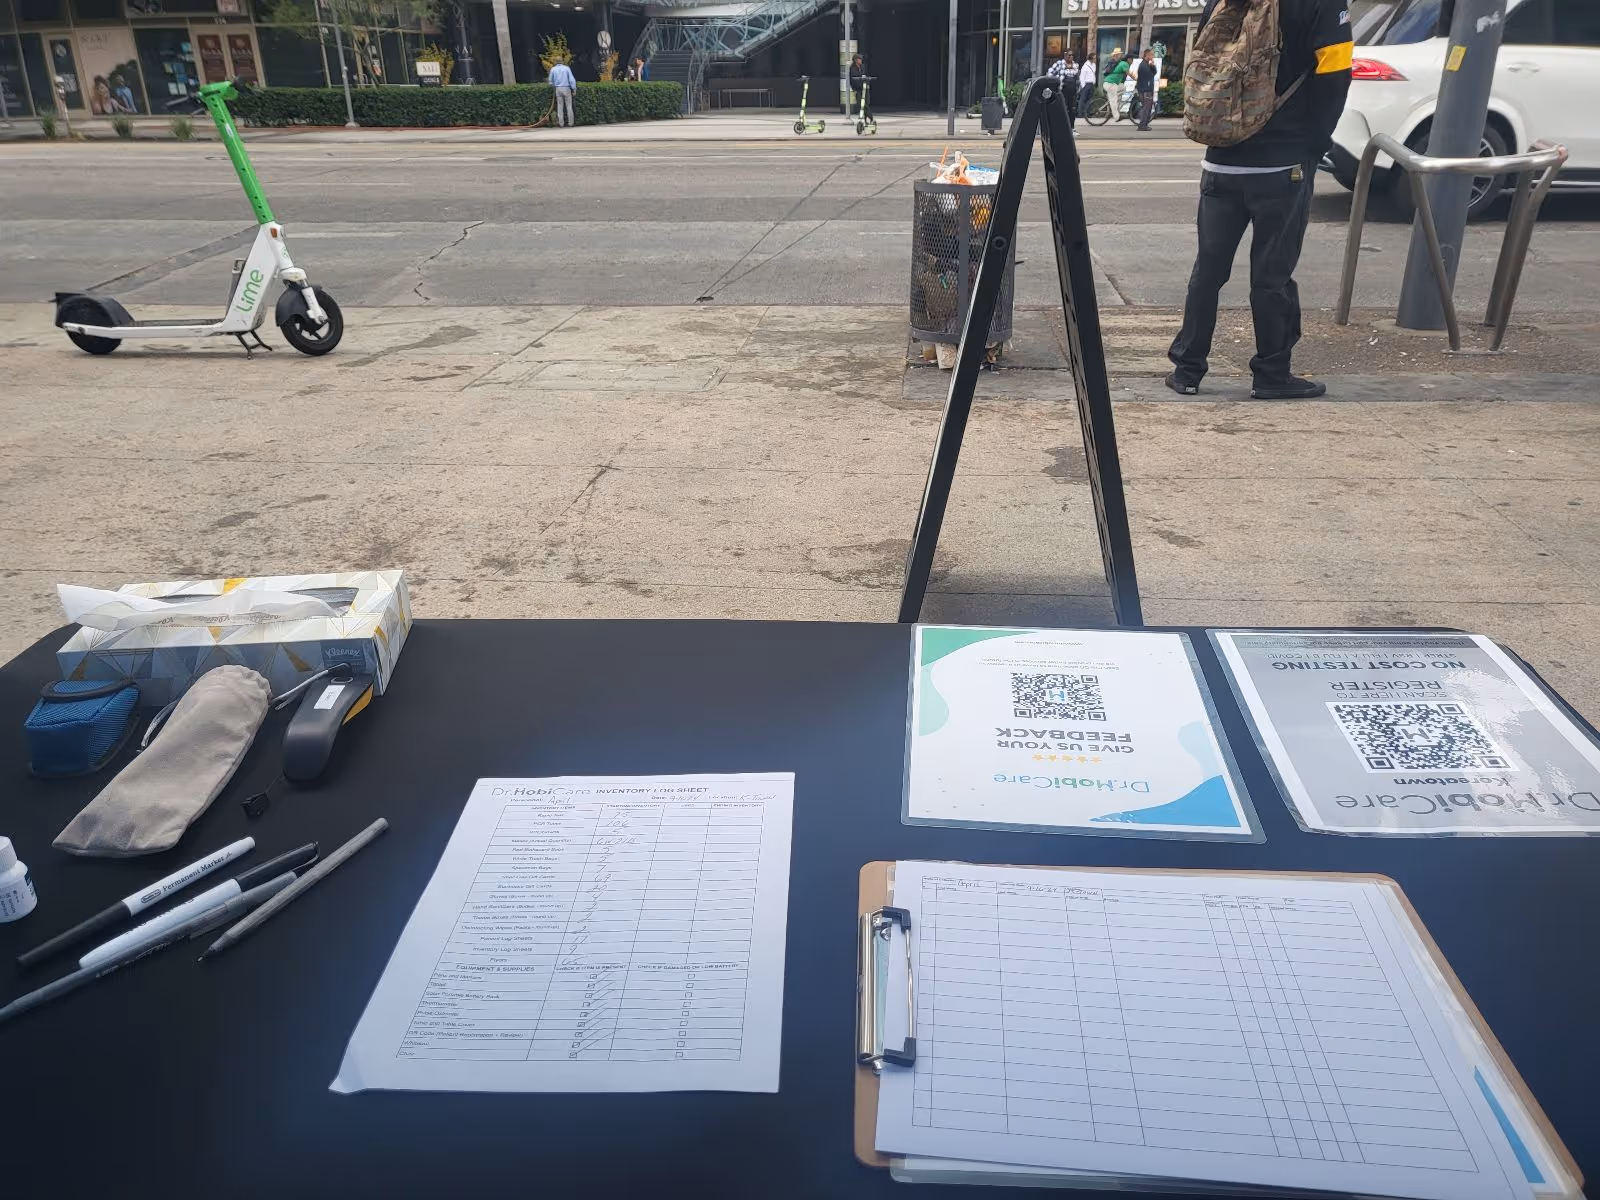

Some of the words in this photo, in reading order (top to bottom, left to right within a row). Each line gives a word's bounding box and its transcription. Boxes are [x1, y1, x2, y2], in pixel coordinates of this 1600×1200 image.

[1272, 661, 1363, 670] TESTING
[1366, 661, 1427, 670] COST
[1431, 661, 1466, 670] NO
[1328, 680, 1442, 690] REGISTER
[994, 728, 1132, 743] FEEDBACK
[996, 740, 1051, 750] YOUR
[1057, 742, 1083, 751] US
[1088, 744, 1135, 754] GIVE
[1392, 776, 1511, 787] Koreatown
[162, 869, 200, 892] Permanent
[200, 856, 224, 872] Marker
